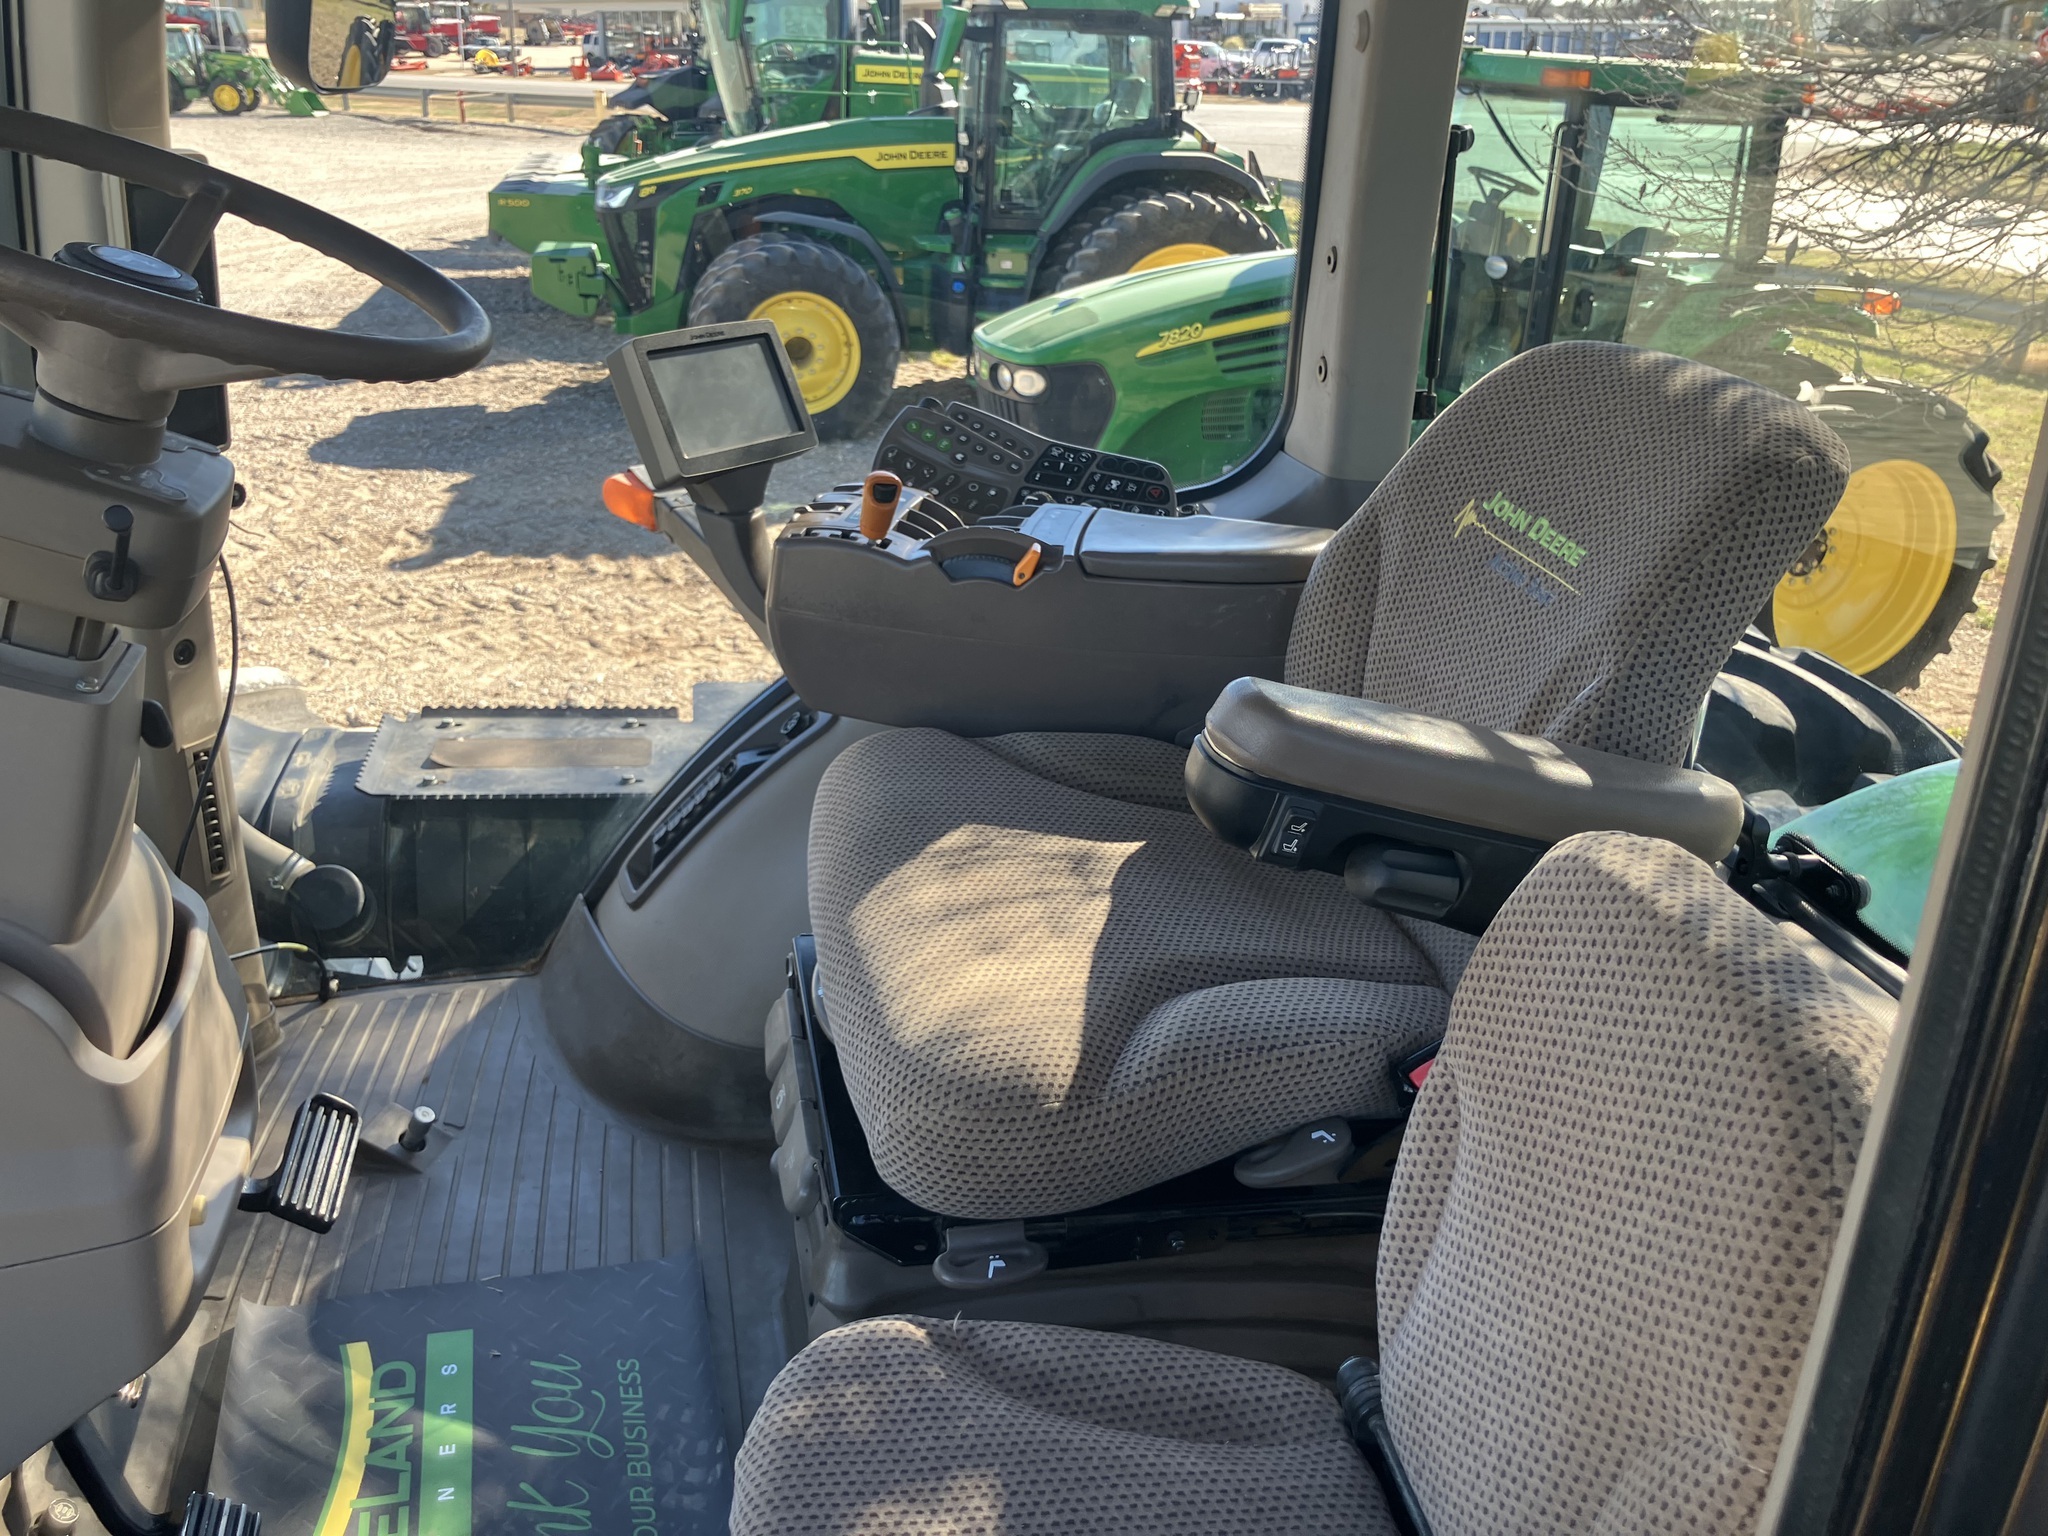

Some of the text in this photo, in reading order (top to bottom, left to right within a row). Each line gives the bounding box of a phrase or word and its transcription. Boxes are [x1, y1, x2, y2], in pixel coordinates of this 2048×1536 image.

[861, 68, 922, 80] JOHN DER
[876, 149, 949, 162] JOHN DEERE
[1158, 321, 1205, 349] 7820
[1482, 491, 1588, 568] JOHN DEERE
[510, 1353, 615, 1459] You
[616, 1358, 652, 1477] BUSINESS
